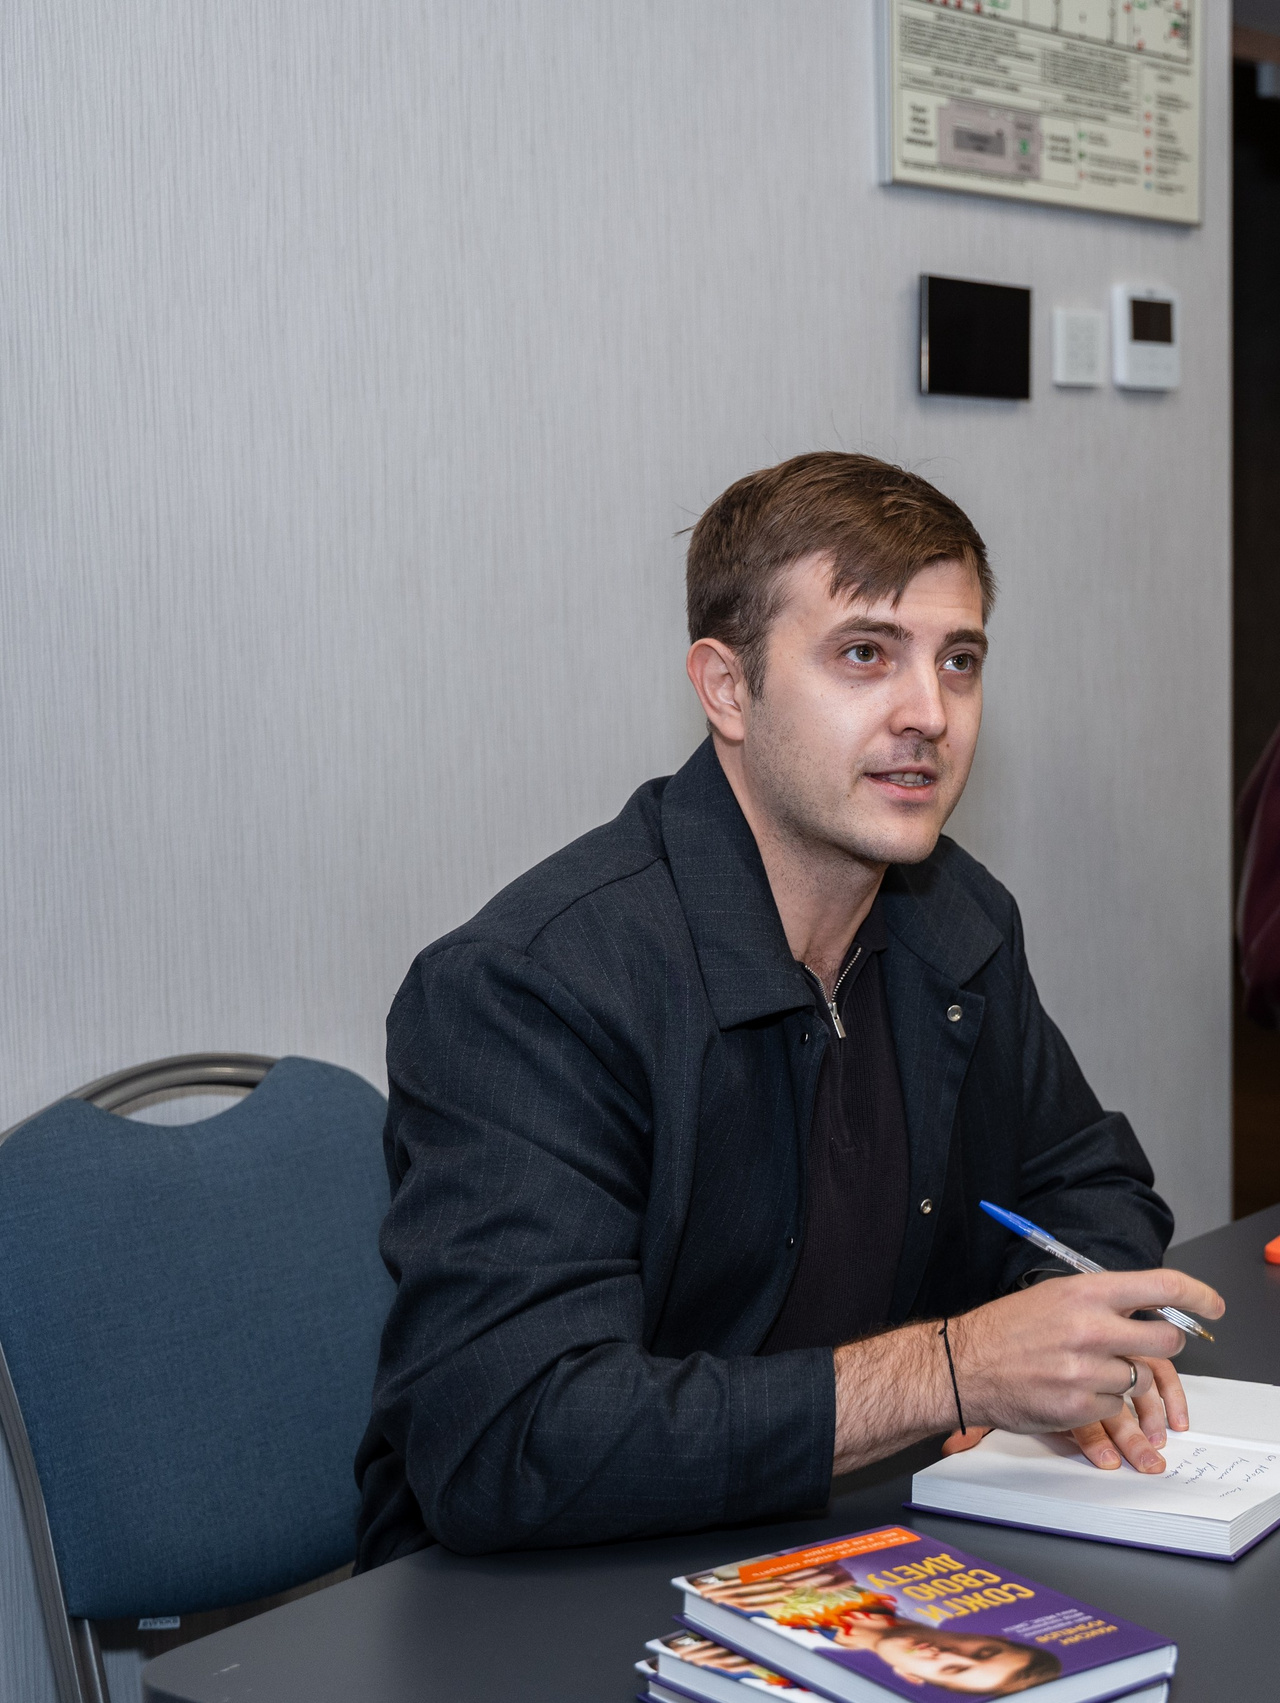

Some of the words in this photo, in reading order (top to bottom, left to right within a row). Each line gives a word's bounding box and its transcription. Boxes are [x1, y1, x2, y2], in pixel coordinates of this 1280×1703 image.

[886, 1535, 908, 1544] Как
[838, 1541, 886, 1555] питаться,
[803, 1554, 833, 1564] чтобы
[751, 1562, 800, 1576] потерять
[866, 1552, 966, 1590] ДИЕТУ
[901, 1568, 1002, 1602] СВОЮ
[914, 1582, 1036, 1623] СОЖГИ
